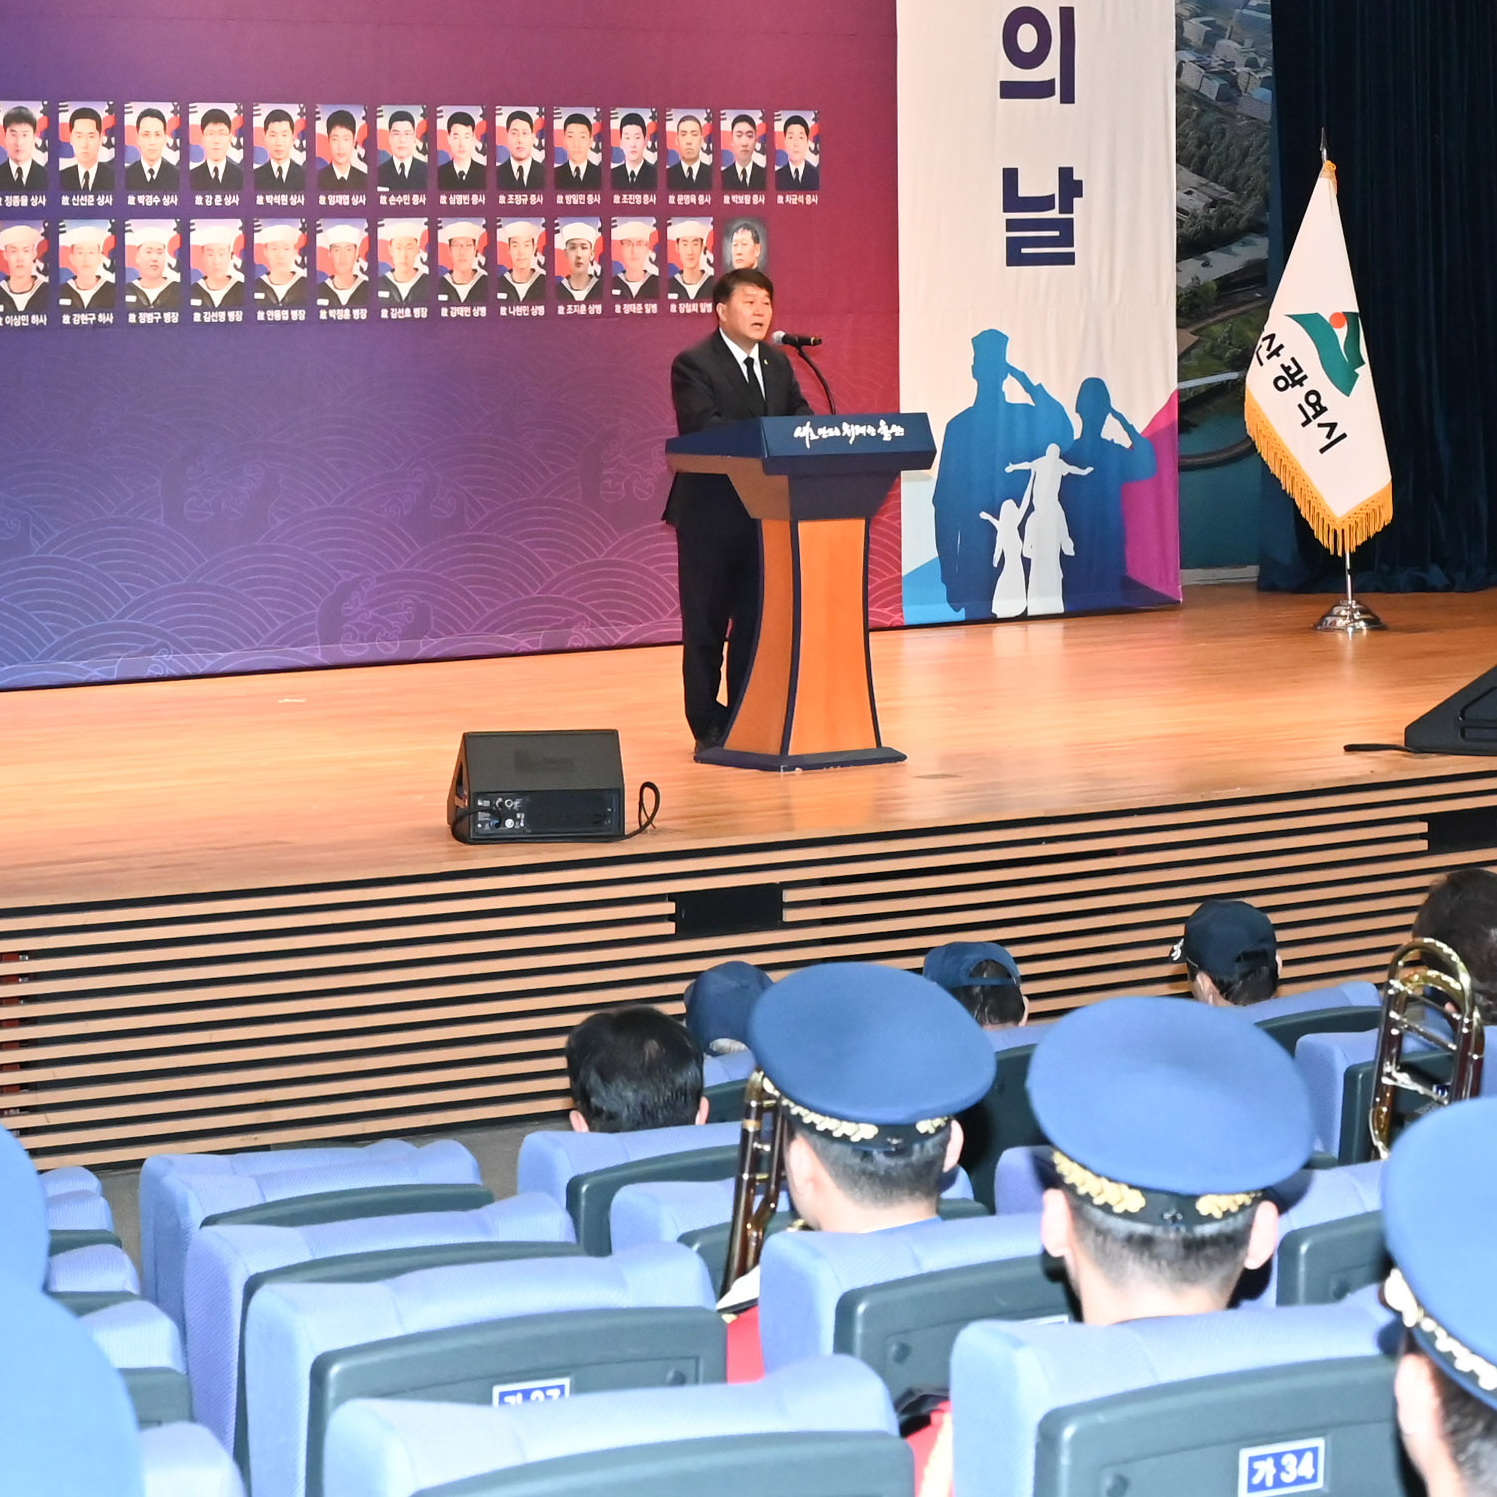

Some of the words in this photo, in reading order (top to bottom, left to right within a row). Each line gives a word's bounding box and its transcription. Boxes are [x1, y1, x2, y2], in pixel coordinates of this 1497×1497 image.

[499, 195, 506, 204] 故
[529, 195, 543, 204] 중사
[1002, 166, 1083, 267] 날
